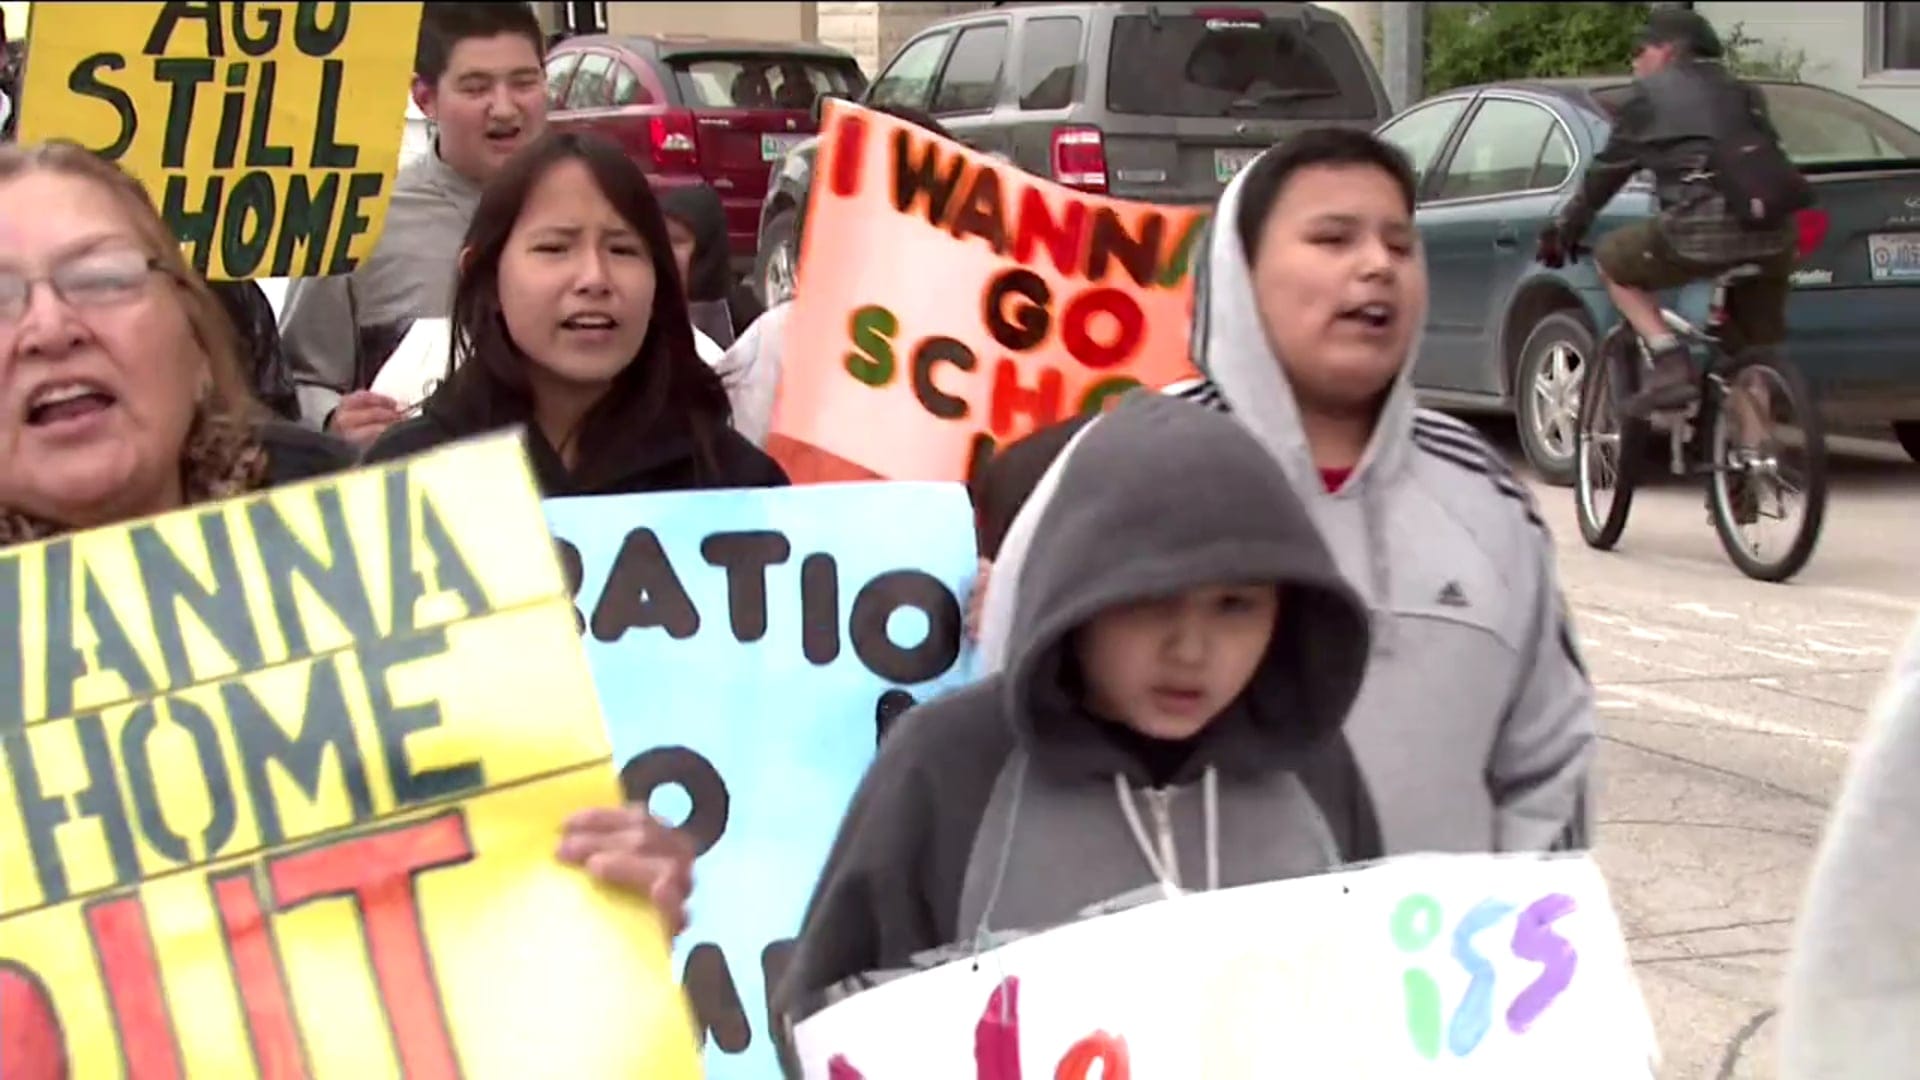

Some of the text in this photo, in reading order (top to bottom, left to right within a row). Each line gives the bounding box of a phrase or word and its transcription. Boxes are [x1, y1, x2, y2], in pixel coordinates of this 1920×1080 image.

[830, 115, 866, 197] I
[163, 171, 384, 278] HOME
[984, 267, 1146, 370] GO
[0, 465, 490, 728] ANNA
[553, 527, 962, 685] ATIO
[3, 627, 485, 901] HOME
